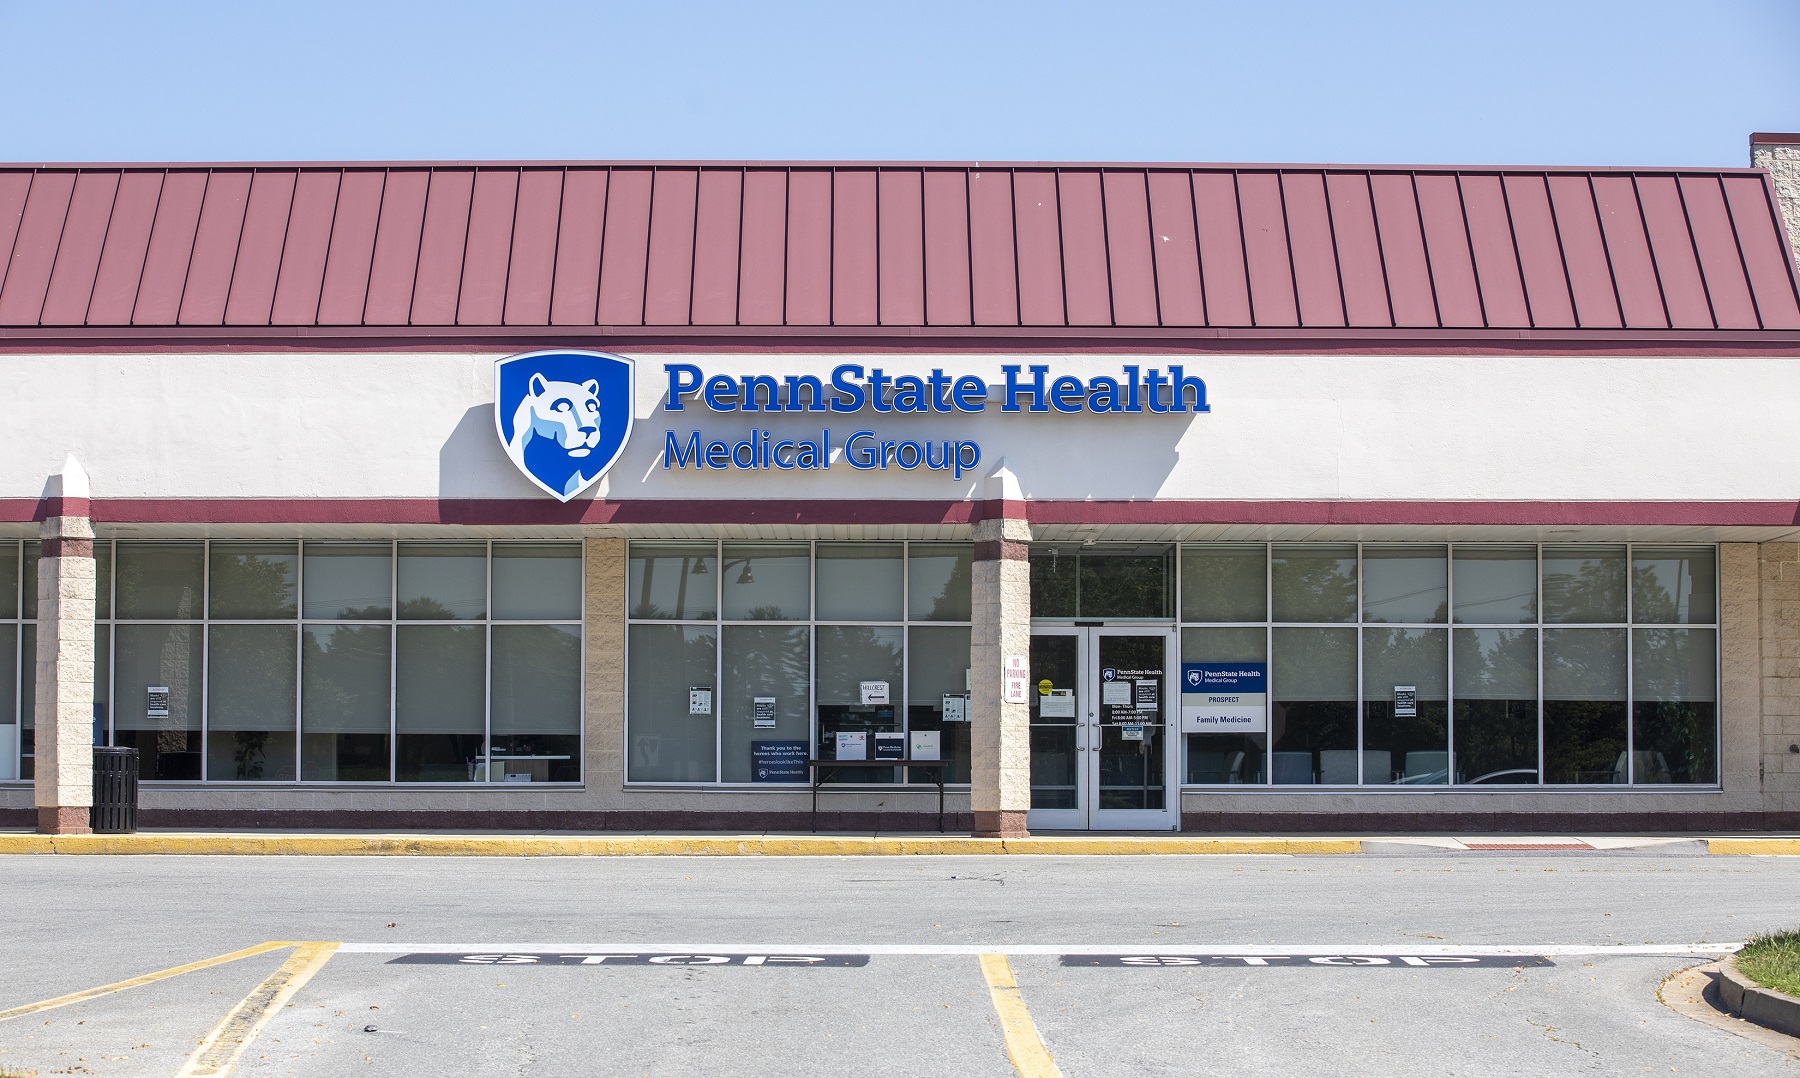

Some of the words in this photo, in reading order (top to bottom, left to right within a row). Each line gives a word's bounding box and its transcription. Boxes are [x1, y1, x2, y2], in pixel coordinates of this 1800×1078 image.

[663, 364, 988, 414] PennState
[1000, 364, 1212, 414] Health
[663, 428, 830, 471] Medical
[844, 431, 982, 480] Group
[1012, 658, 1019, 667] NO
[1007, 669, 1025, 678] PARKING
[1197, 716, 1218, 724] Family
[458, 954, 825, 964] STOP
[1120, 956, 1480, 965] STOP
